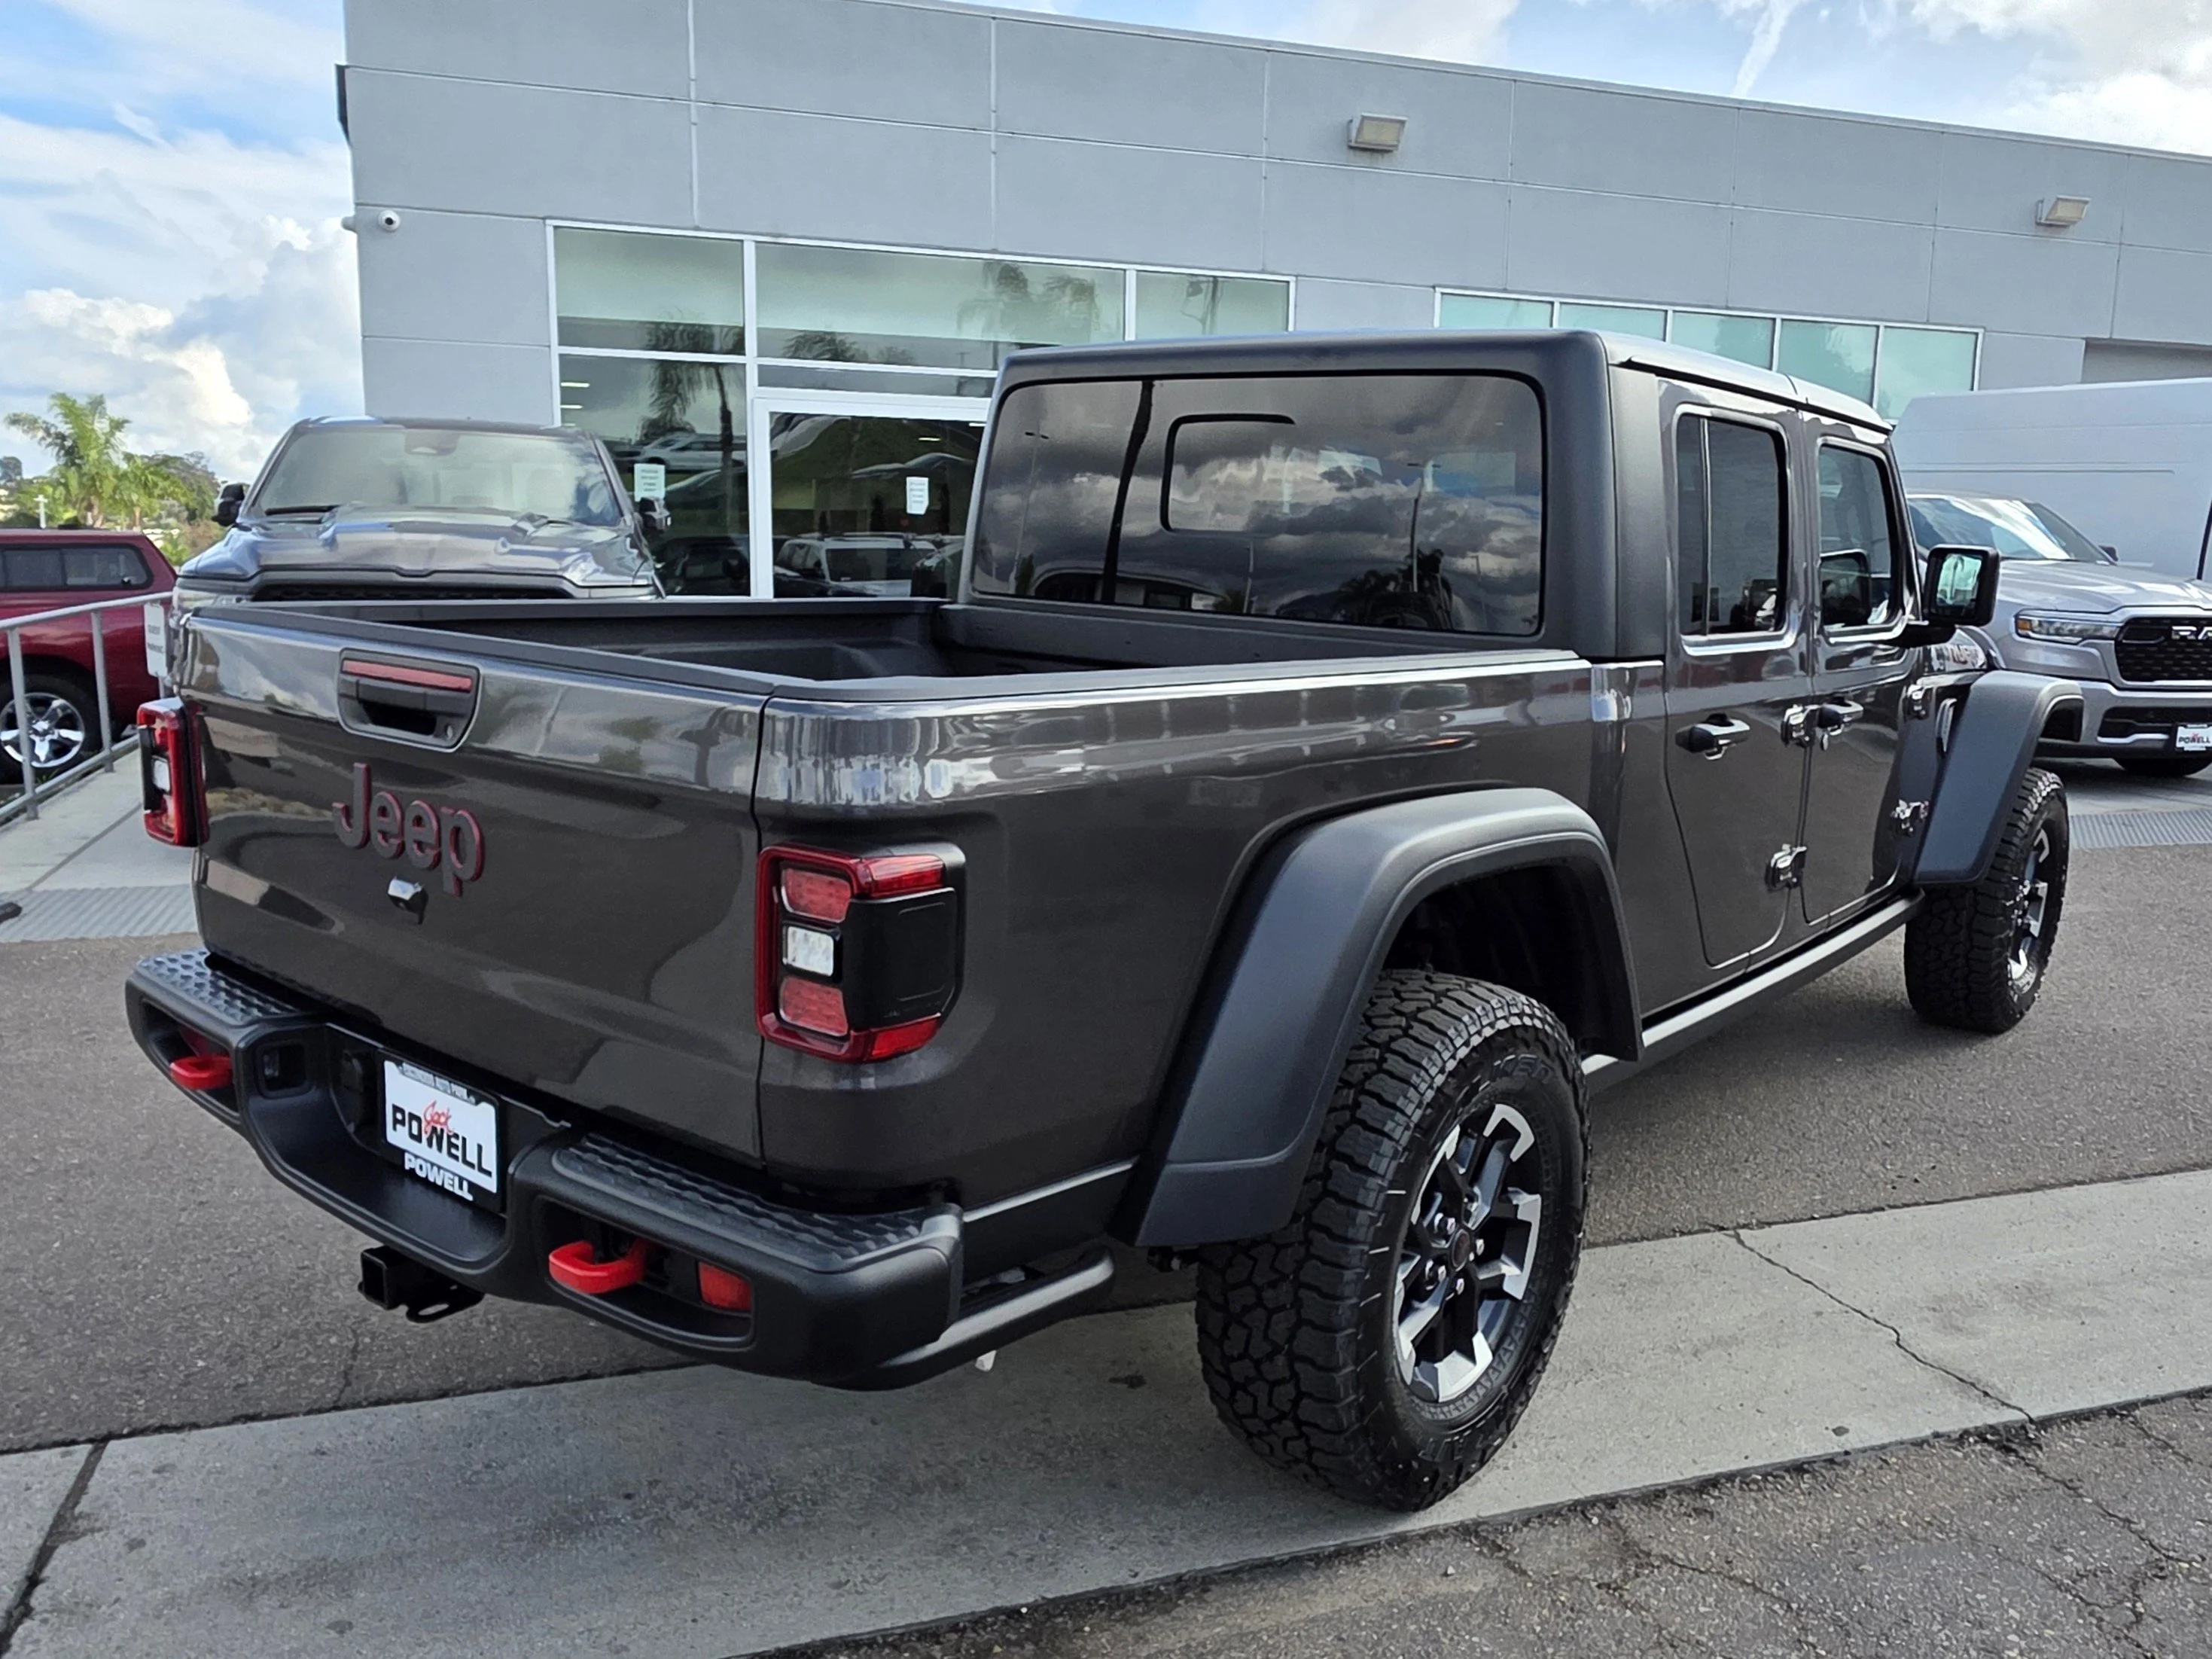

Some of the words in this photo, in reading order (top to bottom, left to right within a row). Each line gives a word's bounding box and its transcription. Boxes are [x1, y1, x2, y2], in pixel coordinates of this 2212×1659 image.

[332, 762, 484, 897] Jeep
[392, 1103, 492, 1179] POWELL
[404, 1151, 474, 1201] POWELL
